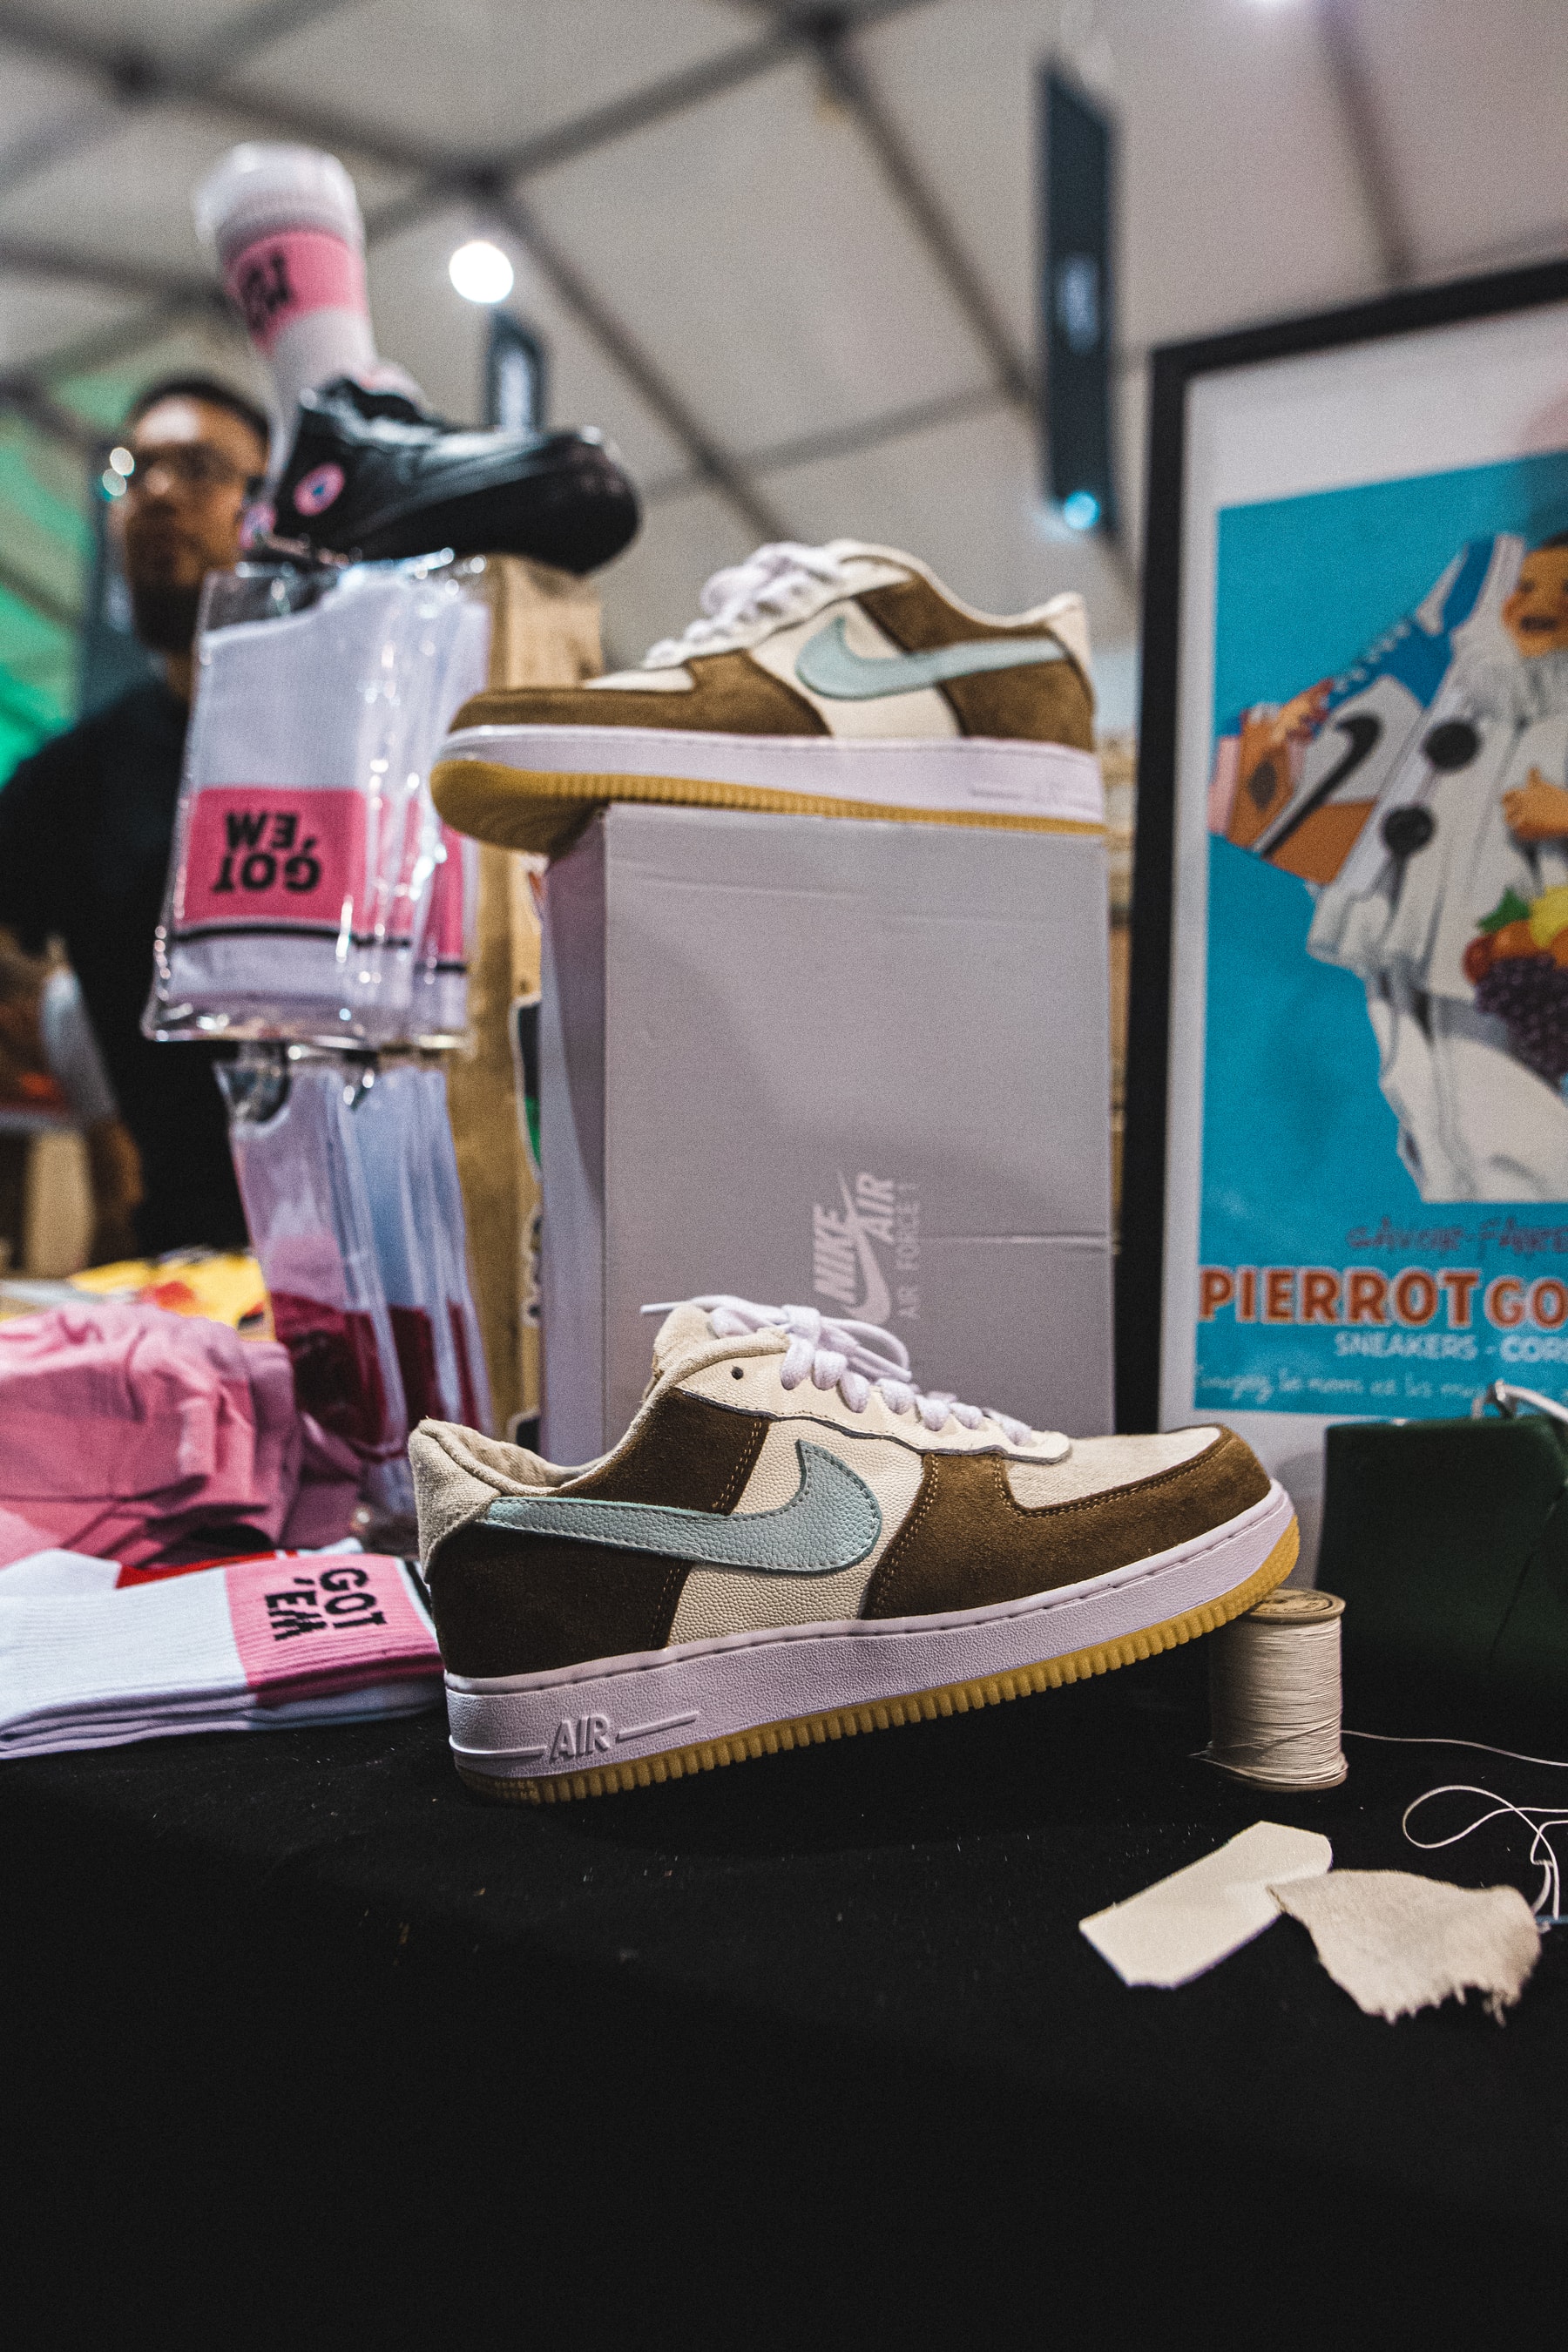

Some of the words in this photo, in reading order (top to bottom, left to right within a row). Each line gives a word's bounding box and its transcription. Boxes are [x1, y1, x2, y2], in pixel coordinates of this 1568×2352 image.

[213, 854, 321, 894] GOT
[855, 1173, 895, 1246] AIR
[896, 1200, 920, 1270] FORCE
[813, 1204, 855, 1305] NIKE
[1200, 1266, 1480, 1328] PIERROT
[1335, 1332, 1477, 1360] SNEAKERS
[319, 1567, 388, 1629] GOT
[549, 1713, 611, 1762] AIR
